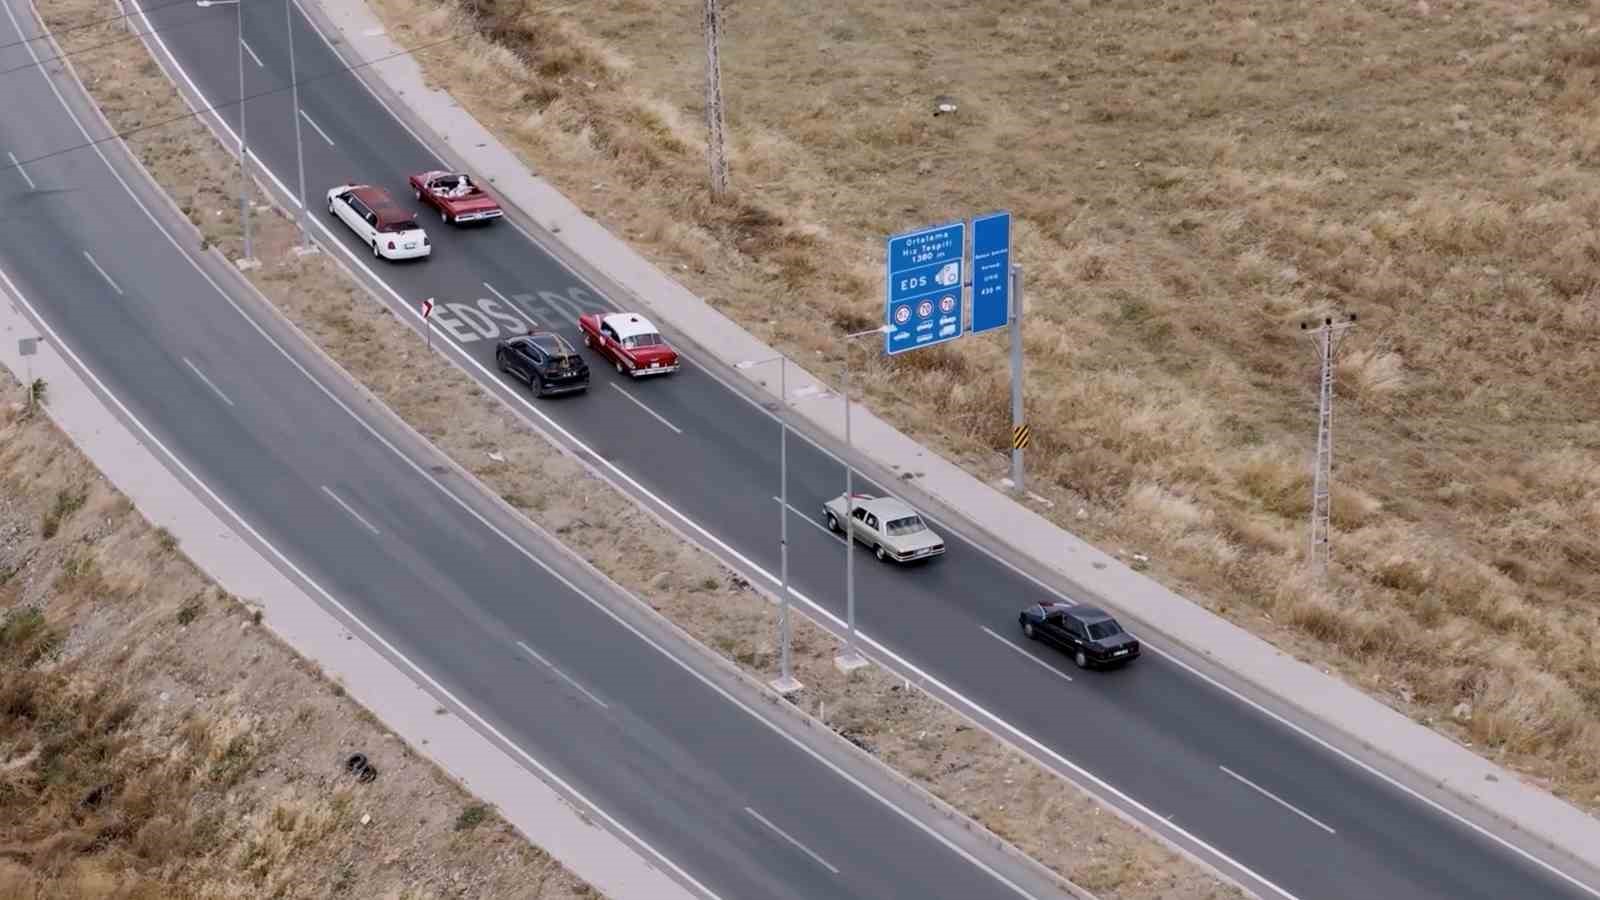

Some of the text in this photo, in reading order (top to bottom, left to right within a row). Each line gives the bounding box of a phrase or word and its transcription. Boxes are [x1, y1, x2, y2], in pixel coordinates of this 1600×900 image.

[905, 232, 949, 246] Ortalama
[922, 240, 952, 252] Tespiti
[901, 276, 927, 291] EDS
[432, 298, 528, 343] EDS
